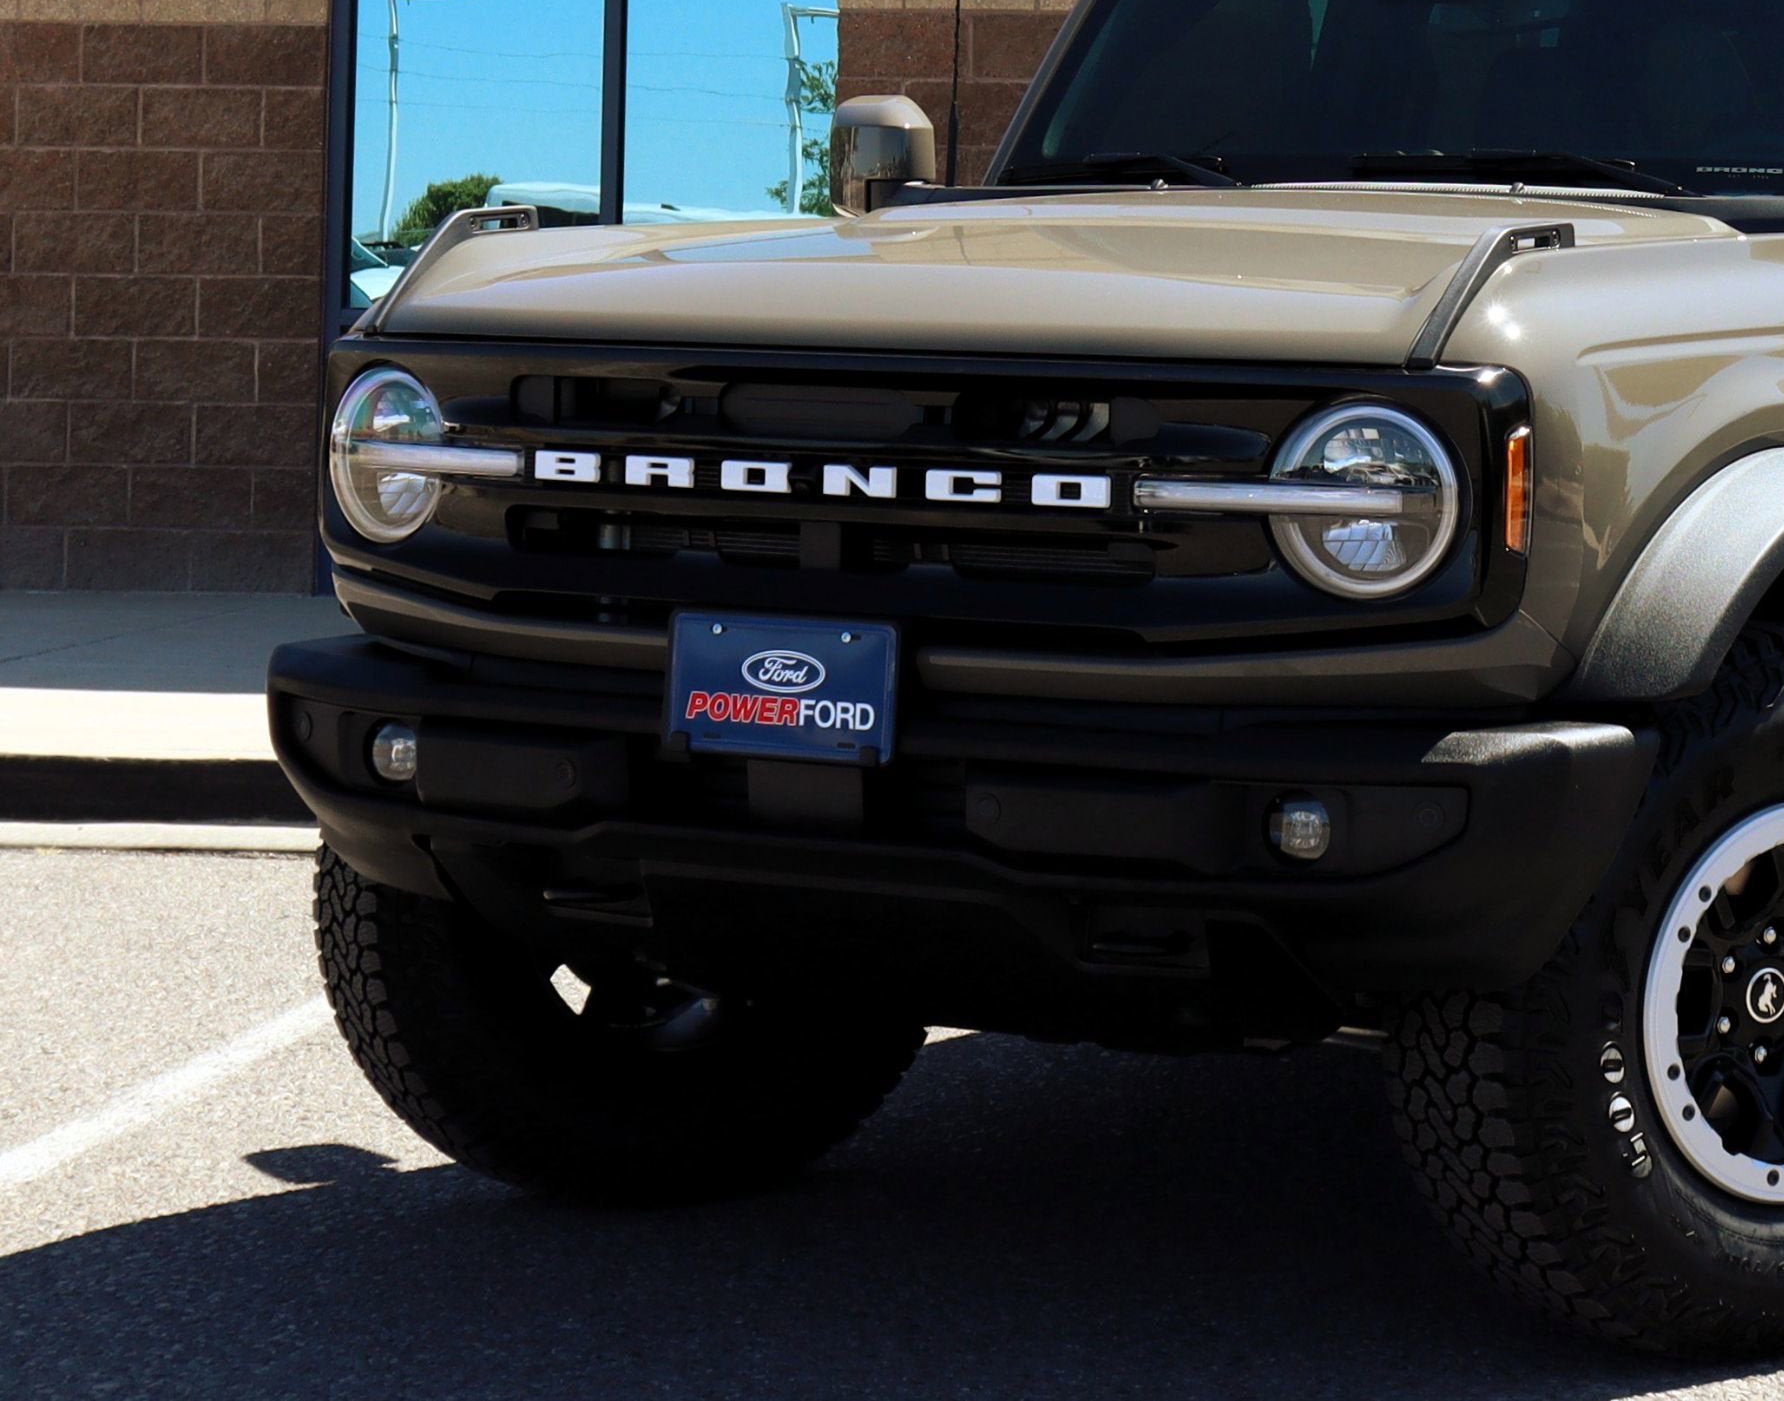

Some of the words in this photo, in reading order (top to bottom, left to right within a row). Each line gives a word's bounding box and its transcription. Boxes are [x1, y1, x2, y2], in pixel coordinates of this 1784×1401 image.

[534, 449, 1111, 509] BRONCO
[758, 656, 809, 684] Ford
[685, 690, 875, 731] POWERFORD
